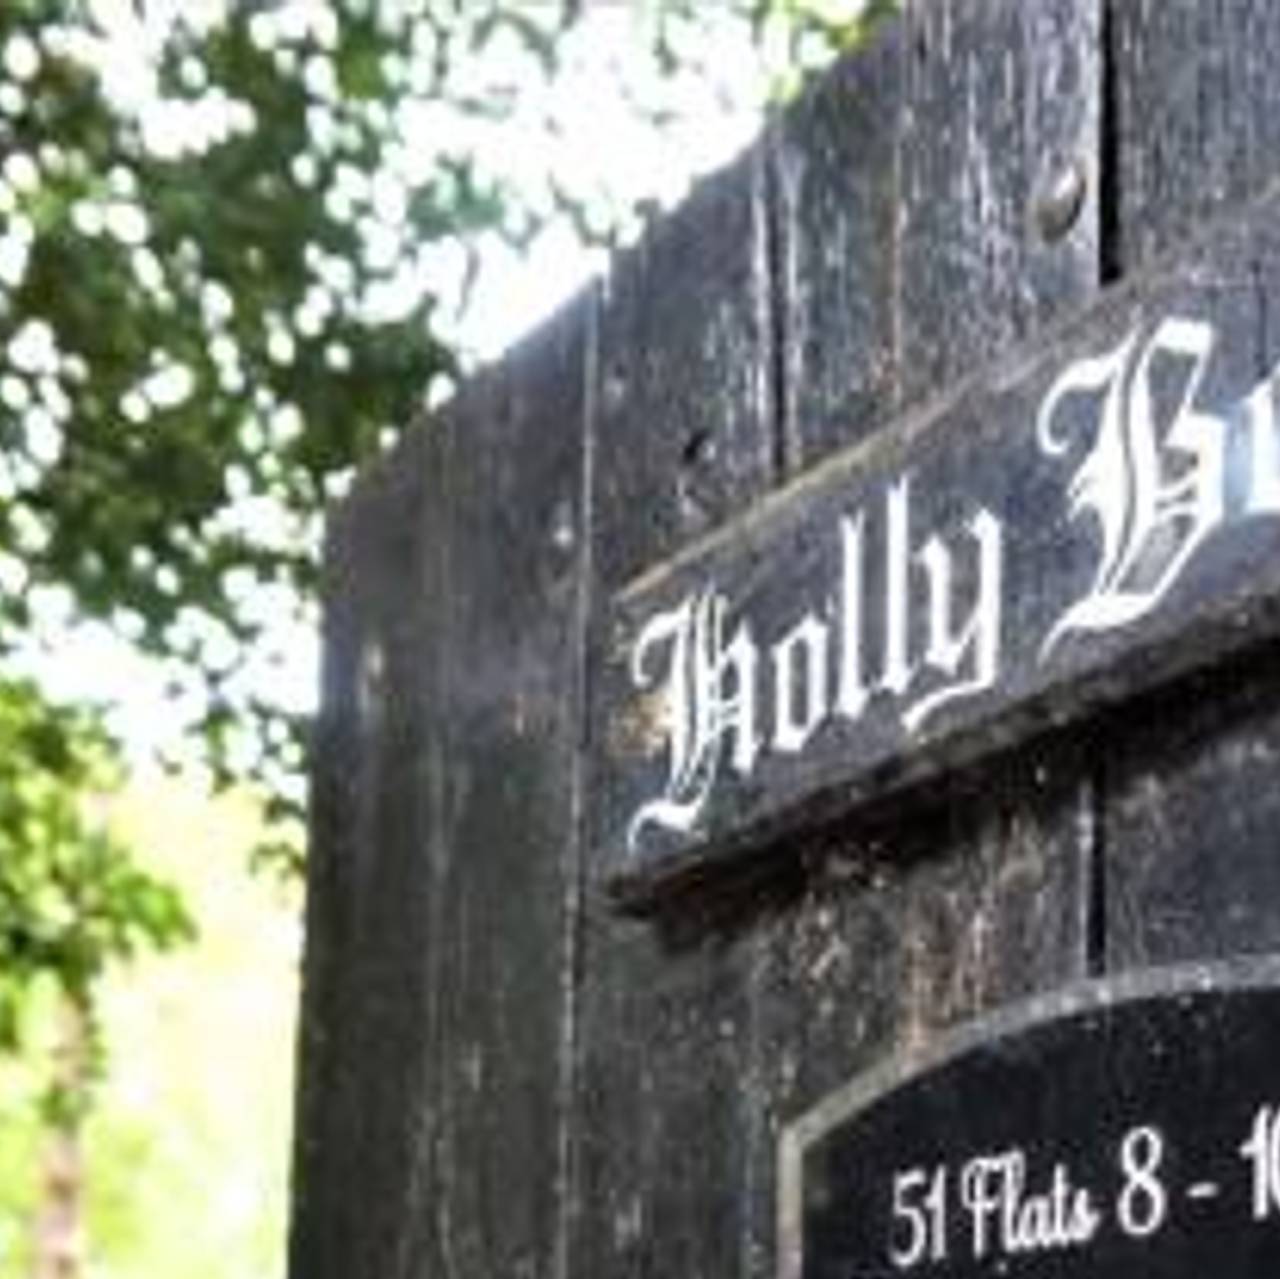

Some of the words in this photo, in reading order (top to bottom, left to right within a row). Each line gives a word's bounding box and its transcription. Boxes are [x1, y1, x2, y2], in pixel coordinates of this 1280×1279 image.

[628, 474, 1003, 855] Holly
[891, 1165, 947, 1266] 51
[961, 1152, 1102, 1257] Flats
[1118, 1125, 1166, 1237] 8
